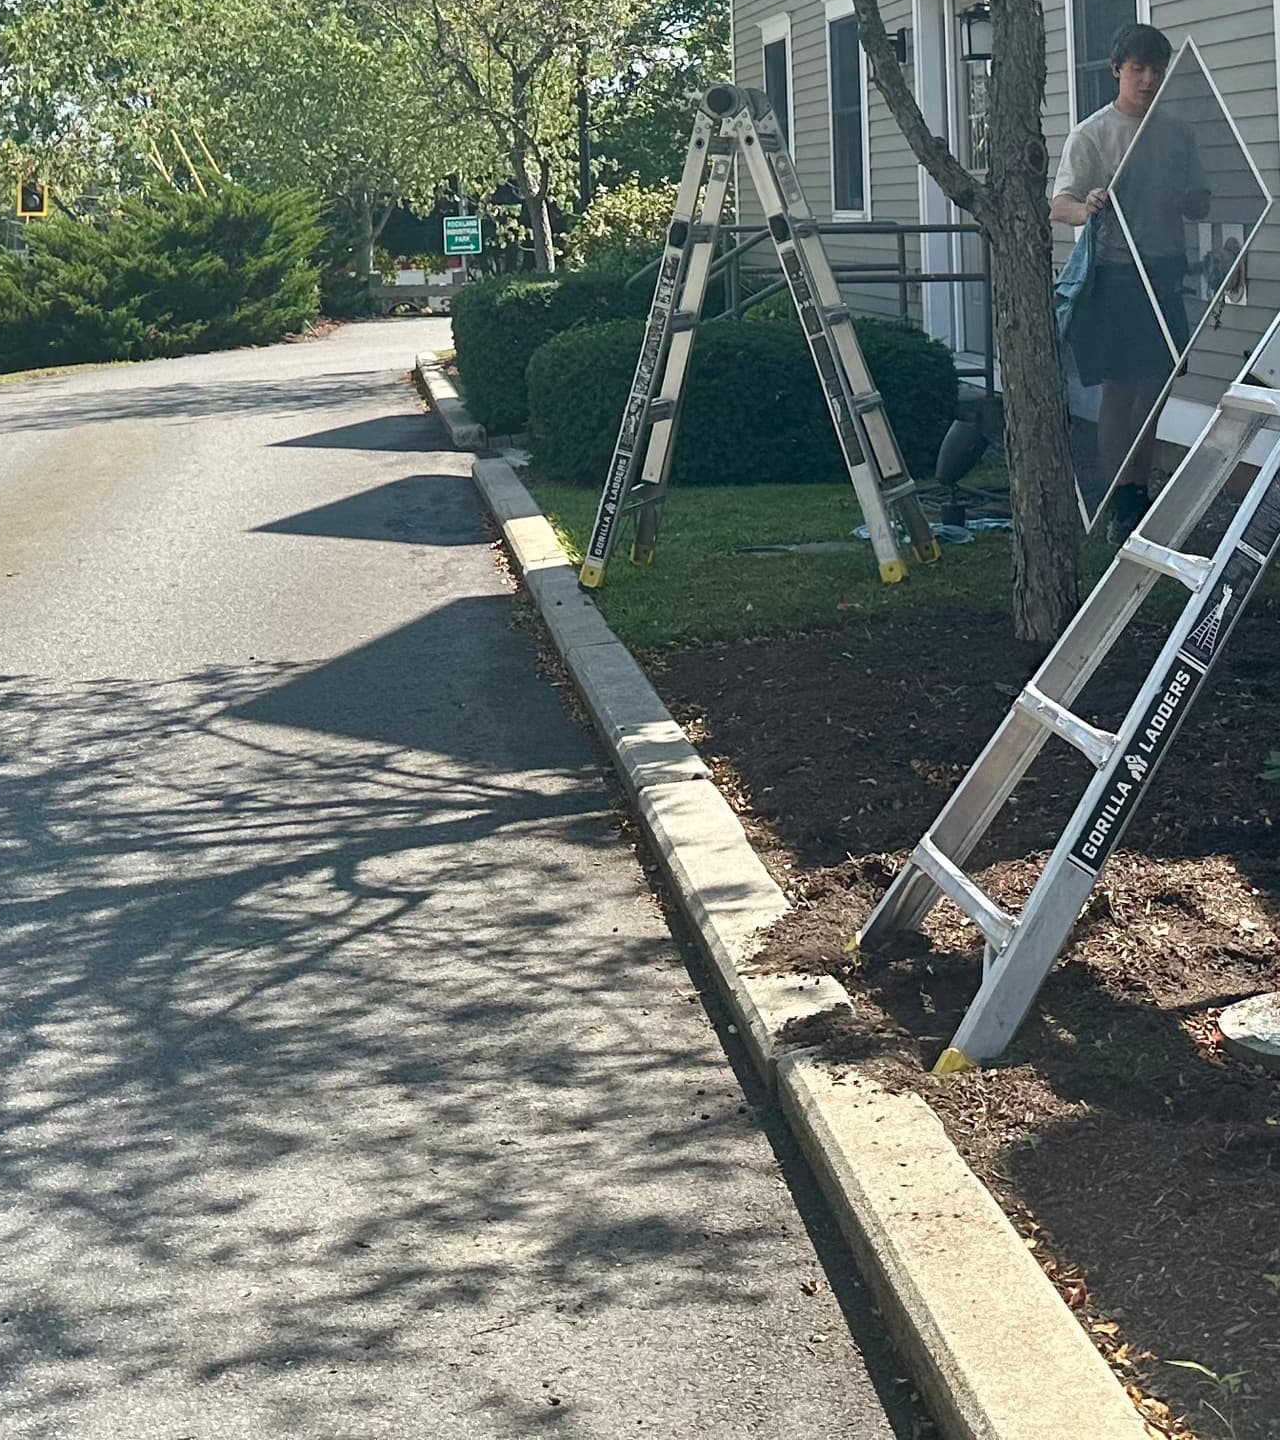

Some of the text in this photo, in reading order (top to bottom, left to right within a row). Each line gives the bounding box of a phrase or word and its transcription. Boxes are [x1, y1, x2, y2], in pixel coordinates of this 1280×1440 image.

[455, 235, 471, 243] PARK
[609, 458, 627, 501] LADDERS
[1081, 669, 1191, 860] GORILLA LADDERS
